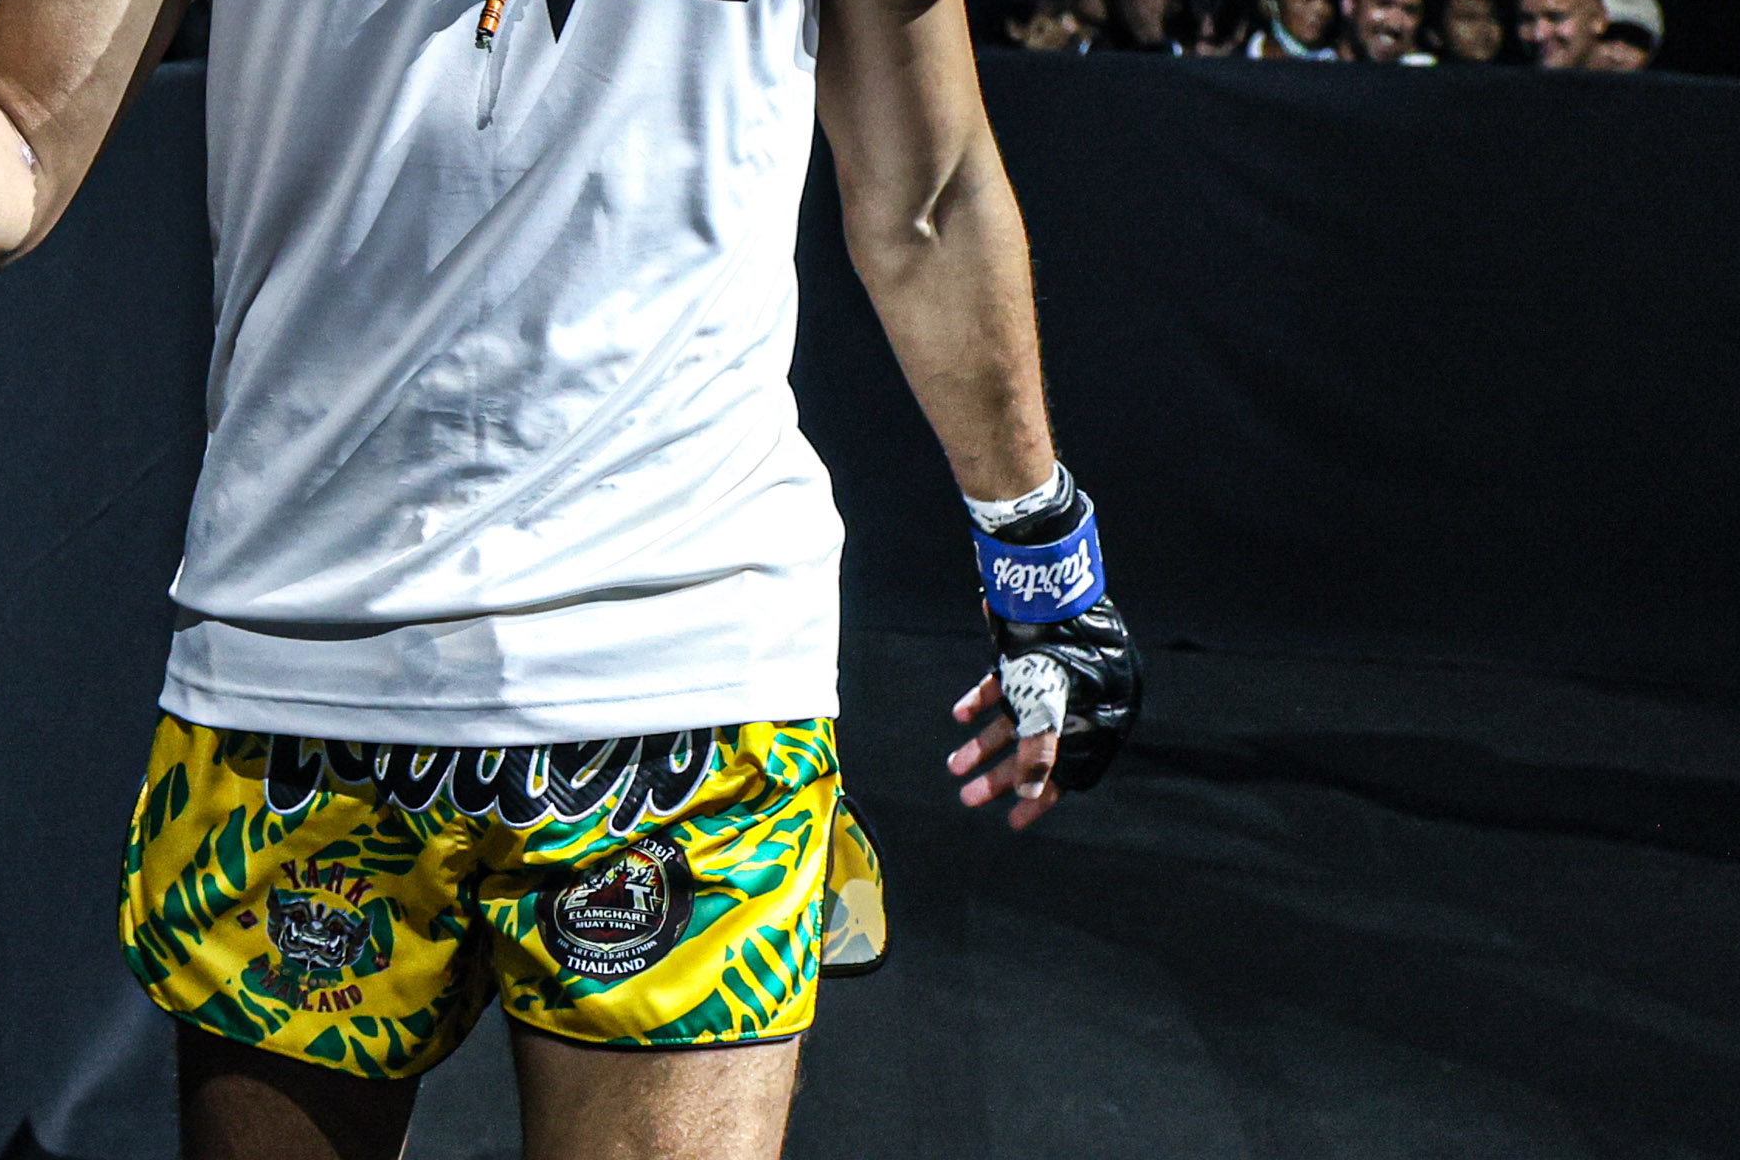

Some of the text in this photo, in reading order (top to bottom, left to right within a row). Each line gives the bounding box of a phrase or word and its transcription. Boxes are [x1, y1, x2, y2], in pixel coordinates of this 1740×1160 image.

[993, 538, 1095, 609] Fairtex
[280, 858, 374, 907] YARK
[568, 909, 646, 923] ELAMGHARI
[575, 921, 636, 930] MUAY THAI
[572, 947, 588, 957] ART
[567, 954, 646, 974] THAILAND
[249, 953, 363, 1013] THAILAND
